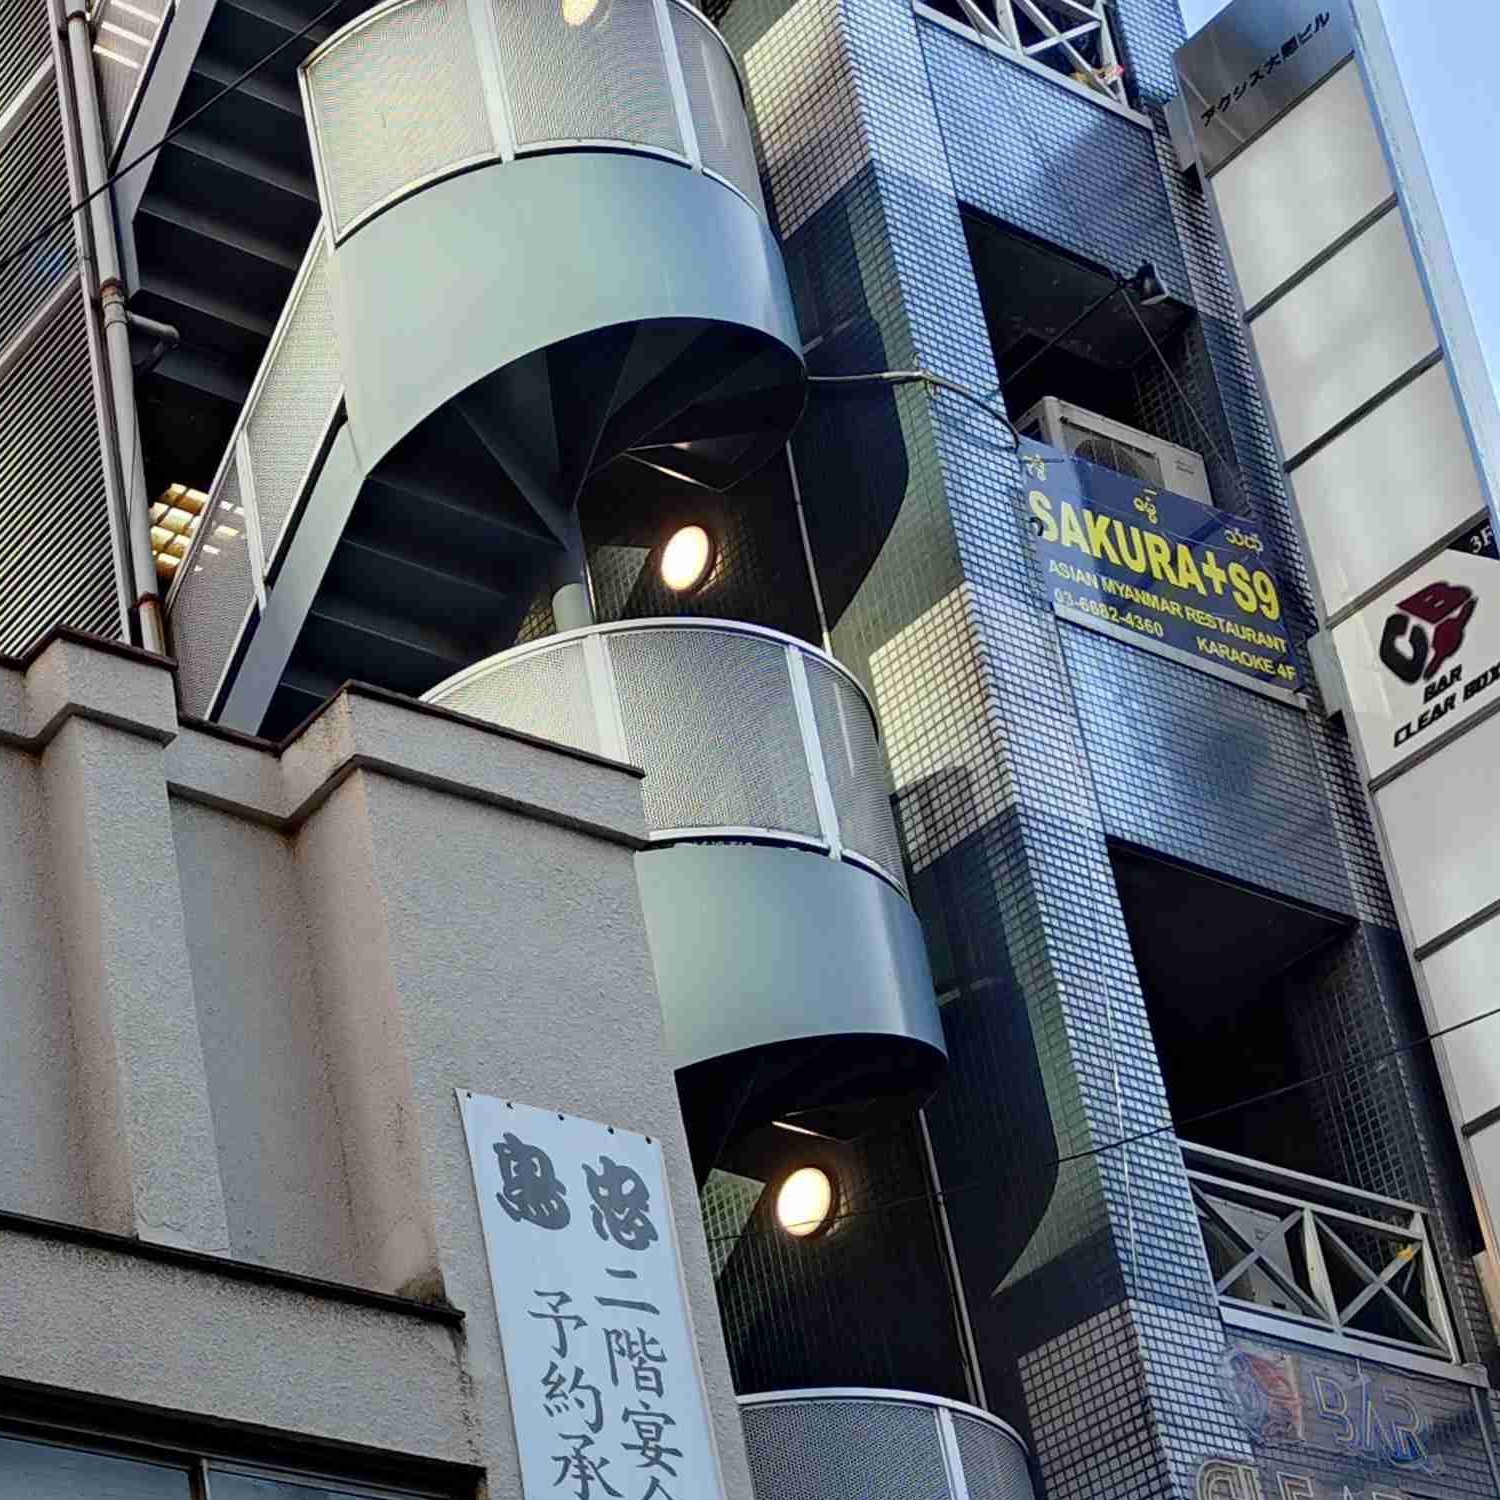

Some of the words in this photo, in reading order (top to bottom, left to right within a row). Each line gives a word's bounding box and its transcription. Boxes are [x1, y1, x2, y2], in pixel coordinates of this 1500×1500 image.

[1028, 490, 1281, 621] SAKURA+S9
[1469, 525, 1494, 553] 3F
[1050, 559, 1099, 590] ASIAN
[1102, 577, 1185, 618] MYANMAR
[1185, 602, 1288, 653] RESTAURANT
[1196, 636, 1274, 675] KARAOKE
[1276, 660, 1298, 681] 4F
[1423, 663, 1463, 705] BAR
[1393, 692, 1457, 748] CLEAR
[492, 1130, 660, 1252] 鳥忠
